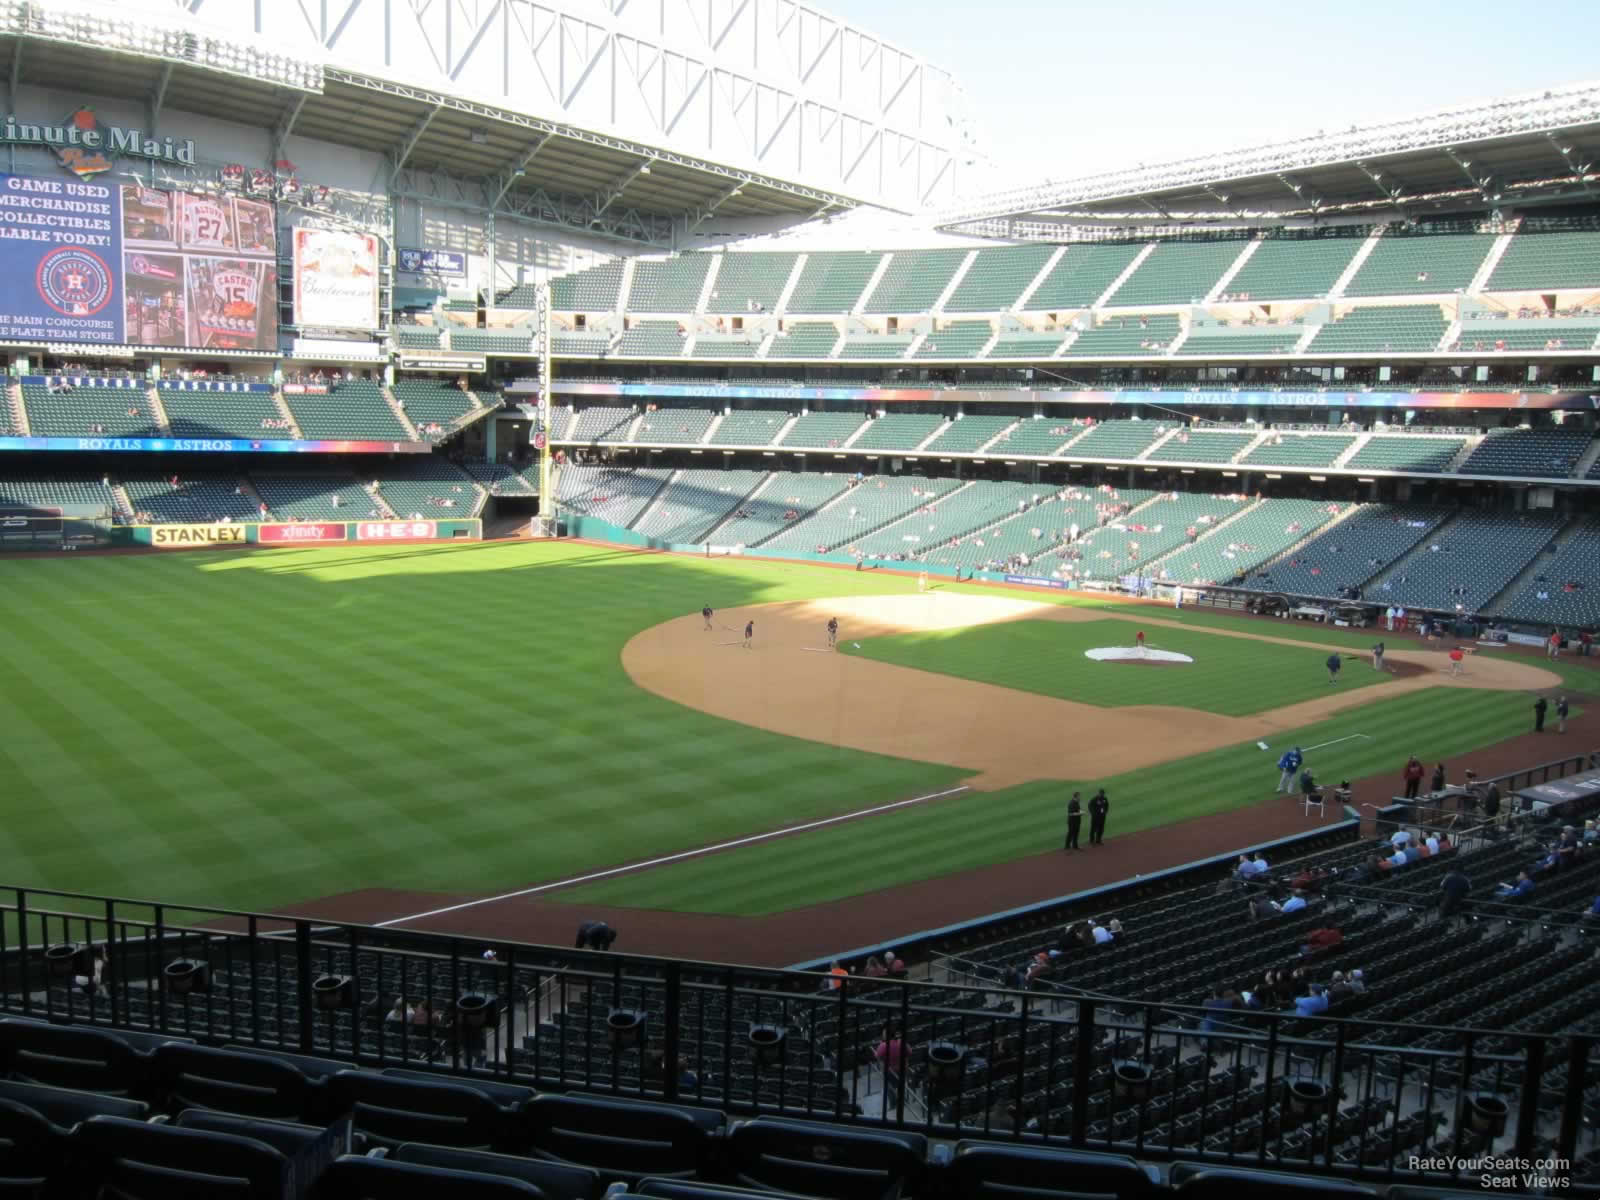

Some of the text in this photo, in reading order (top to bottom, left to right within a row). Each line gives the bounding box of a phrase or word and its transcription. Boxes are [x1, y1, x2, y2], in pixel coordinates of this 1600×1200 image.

[0, 116, 100, 147] inute
[109, 126, 196, 165] Maid
[8, 178, 110, 199] GAME USED
[198, 217, 221, 241] 27
[53, 232, 111, 247] TODAY!
[218, 275, 252, 289] CASTRO
[13, 315, 43, 326] MAIN
[45, 317, 114, 329] CONCOURSE
[11, 327, 45, 336] PLATE
[47, 329, 78, 338] TEAM
[80, 332, 114, 340] STORE
[1184, 392, 1327, 405] ROYALS ASTROS
[79, 439, 232, 451] ROYALS ASTROS
[156, 527, 241, 543] STANLEY
[281, 524, 325, 540] xfinity
